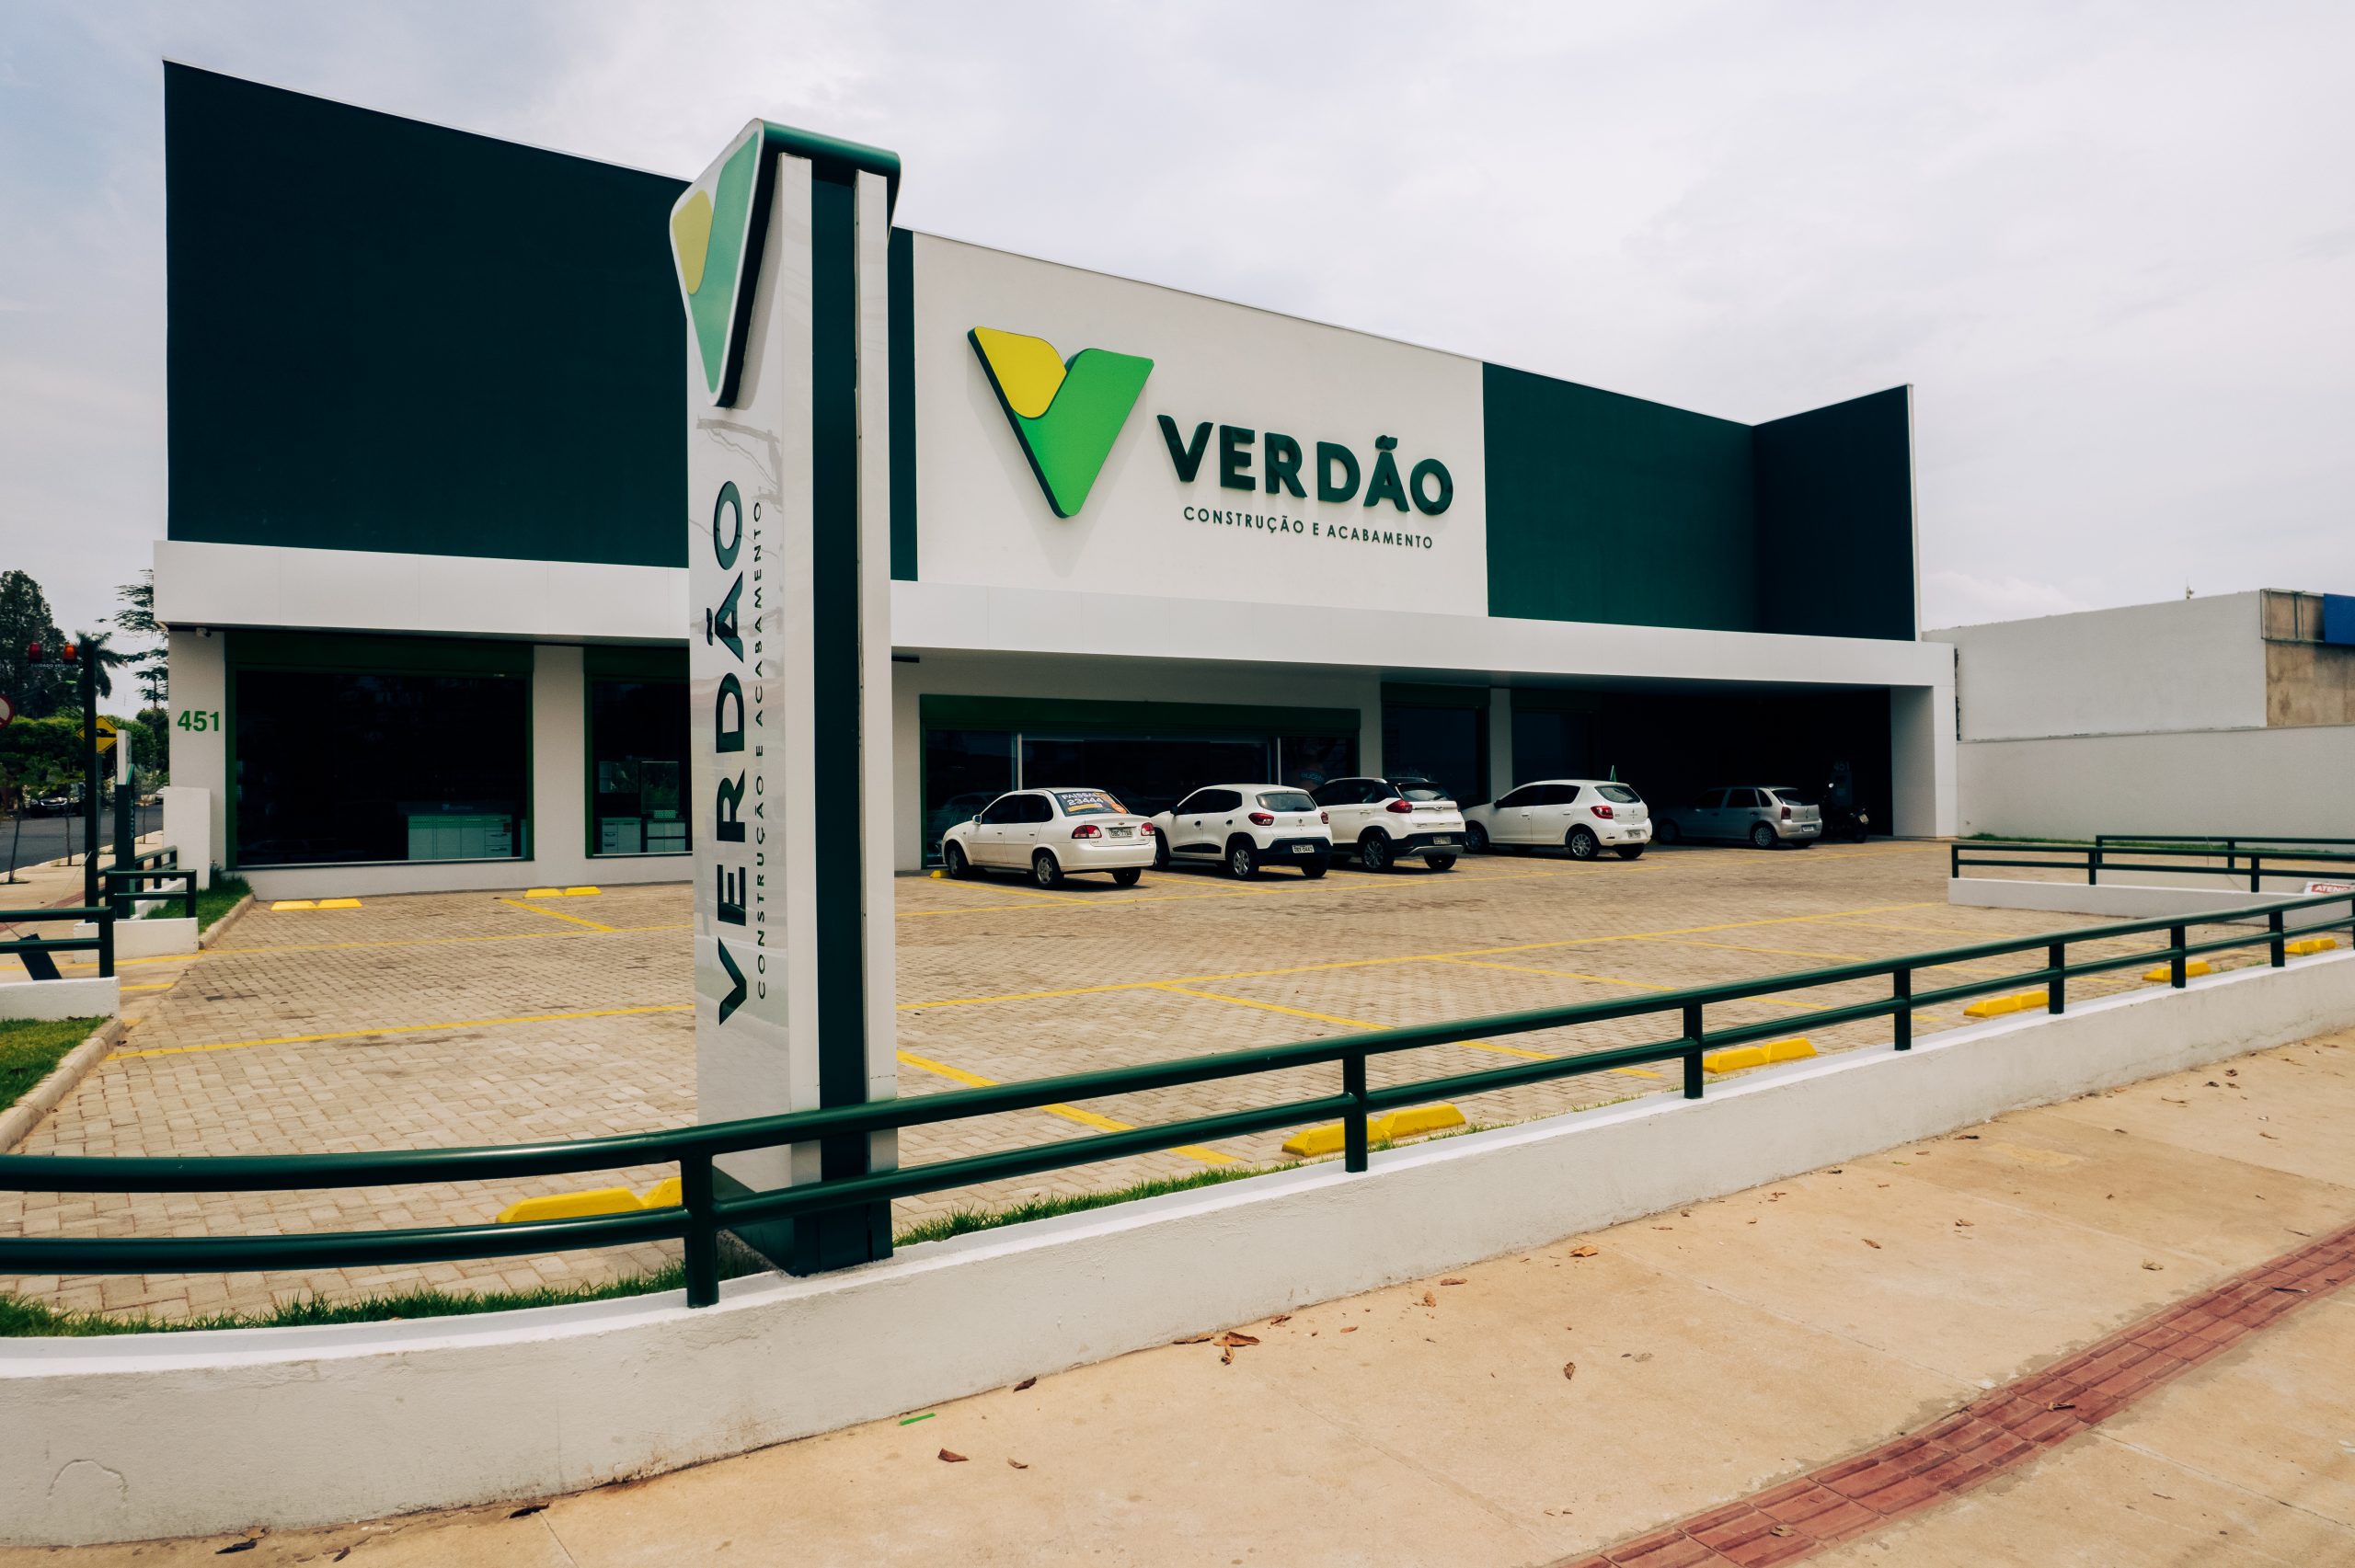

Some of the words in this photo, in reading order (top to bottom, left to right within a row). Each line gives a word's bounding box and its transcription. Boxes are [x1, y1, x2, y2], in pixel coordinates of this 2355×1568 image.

[1156, 414, 1453, 516] VERDÃO
[1183, 506, 1304, 533] CONSTRUÇÃO
[1313, 522, 1320, 536] E
[1327, 525, 1433, 549] ACABAMENTO
[753, 501, 764, 727] ACABAMENTO
[178, 710, 219, 732] 451
[706, 480, 747, 1025] VERDÃO
[755, 745, 764, 757] E
[1067, 797, 1104, 806] 23444
[754, 775, 765, 1000] CONSTRUÇÃO
